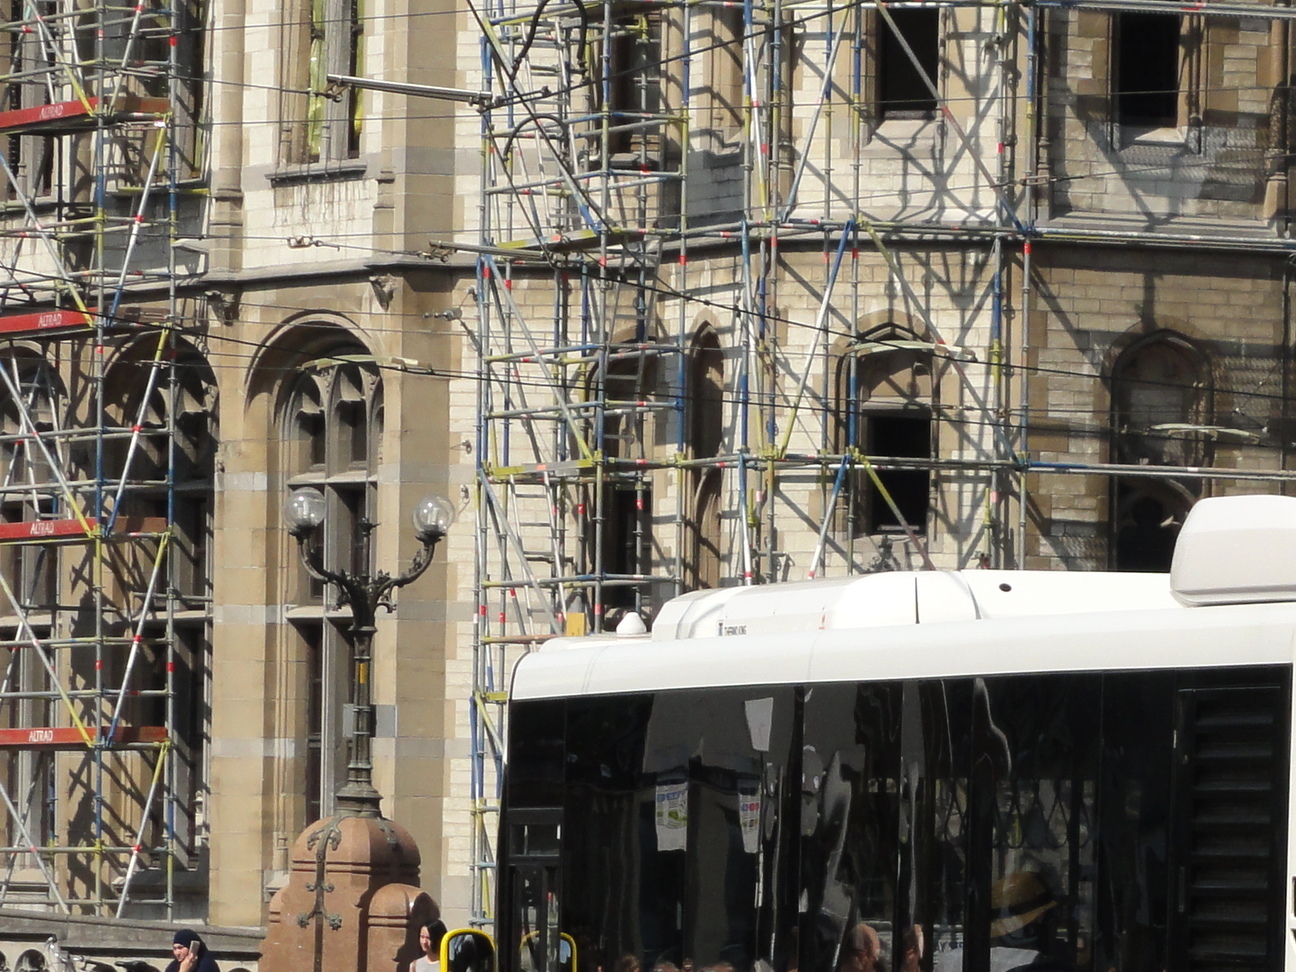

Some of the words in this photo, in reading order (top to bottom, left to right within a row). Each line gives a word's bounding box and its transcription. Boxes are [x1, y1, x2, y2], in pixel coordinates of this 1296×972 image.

[38, 313, 62, 328] ALTRAD
[30, 522, 54, 535] ALTRAD
[28, 730, 54, 742] ALTRAD
